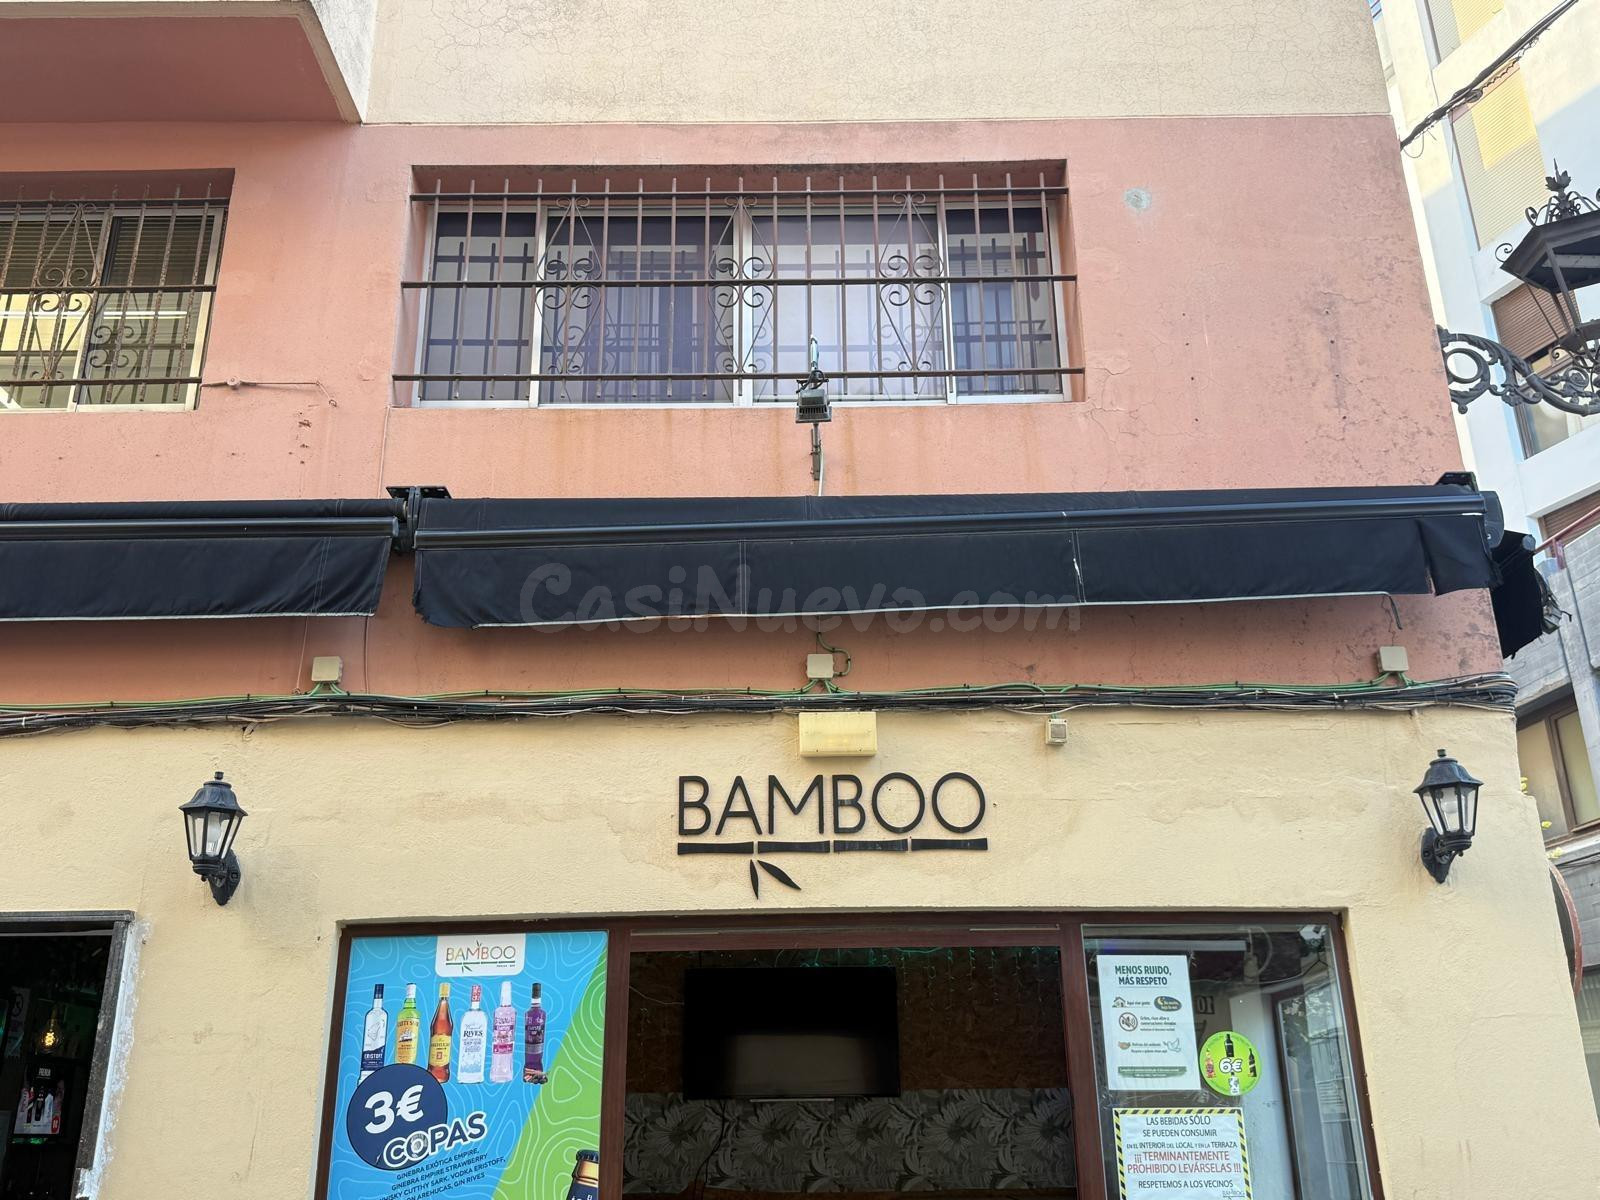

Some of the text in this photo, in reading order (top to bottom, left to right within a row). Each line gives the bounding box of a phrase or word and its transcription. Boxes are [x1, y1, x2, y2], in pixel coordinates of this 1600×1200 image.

[678, 772, 986, 836] BAMBOO
[446, 945, 516, 961] BAMBOO
[1115, 965, 1172, 976] MENOS RUIDO,
[1118, 975, 1168, 985] MÁS RESPETO
[1219, 1057, 1243, 1074] 6€
[365, 1084, 424, 1134] 3€
[1146, 1114, 1211, 1126] LAS BEBIDAS SÓLO
[384, 1111, 487, 1167] COPAS
[1142, 1129, 1217, 1137] SE PUEDEN CONSUMIR
[1142, 1150, 1229, 1161] TERMINANTEMENTE
[392, 1153, 488, 1191] GINEBRA EMPIRE STRAWBERRY
[397, 1167, 425, 1180] GINEBRA
[426, 1158, 453, 1171] EXÓTICA
[451, 1168, 473, 1180] VODKA
[1127, 1164, 1177, 1174] PROHIBIDO
[1179, 1161, 1232, 1174] LEVÁRSELAS
[454, 1179, 465, 1188] GIN
[466, 1172, 486, 1183] RIVES
[1138, 1179, 1234, 1188] RESPETEMOS A LOS VECINOS
